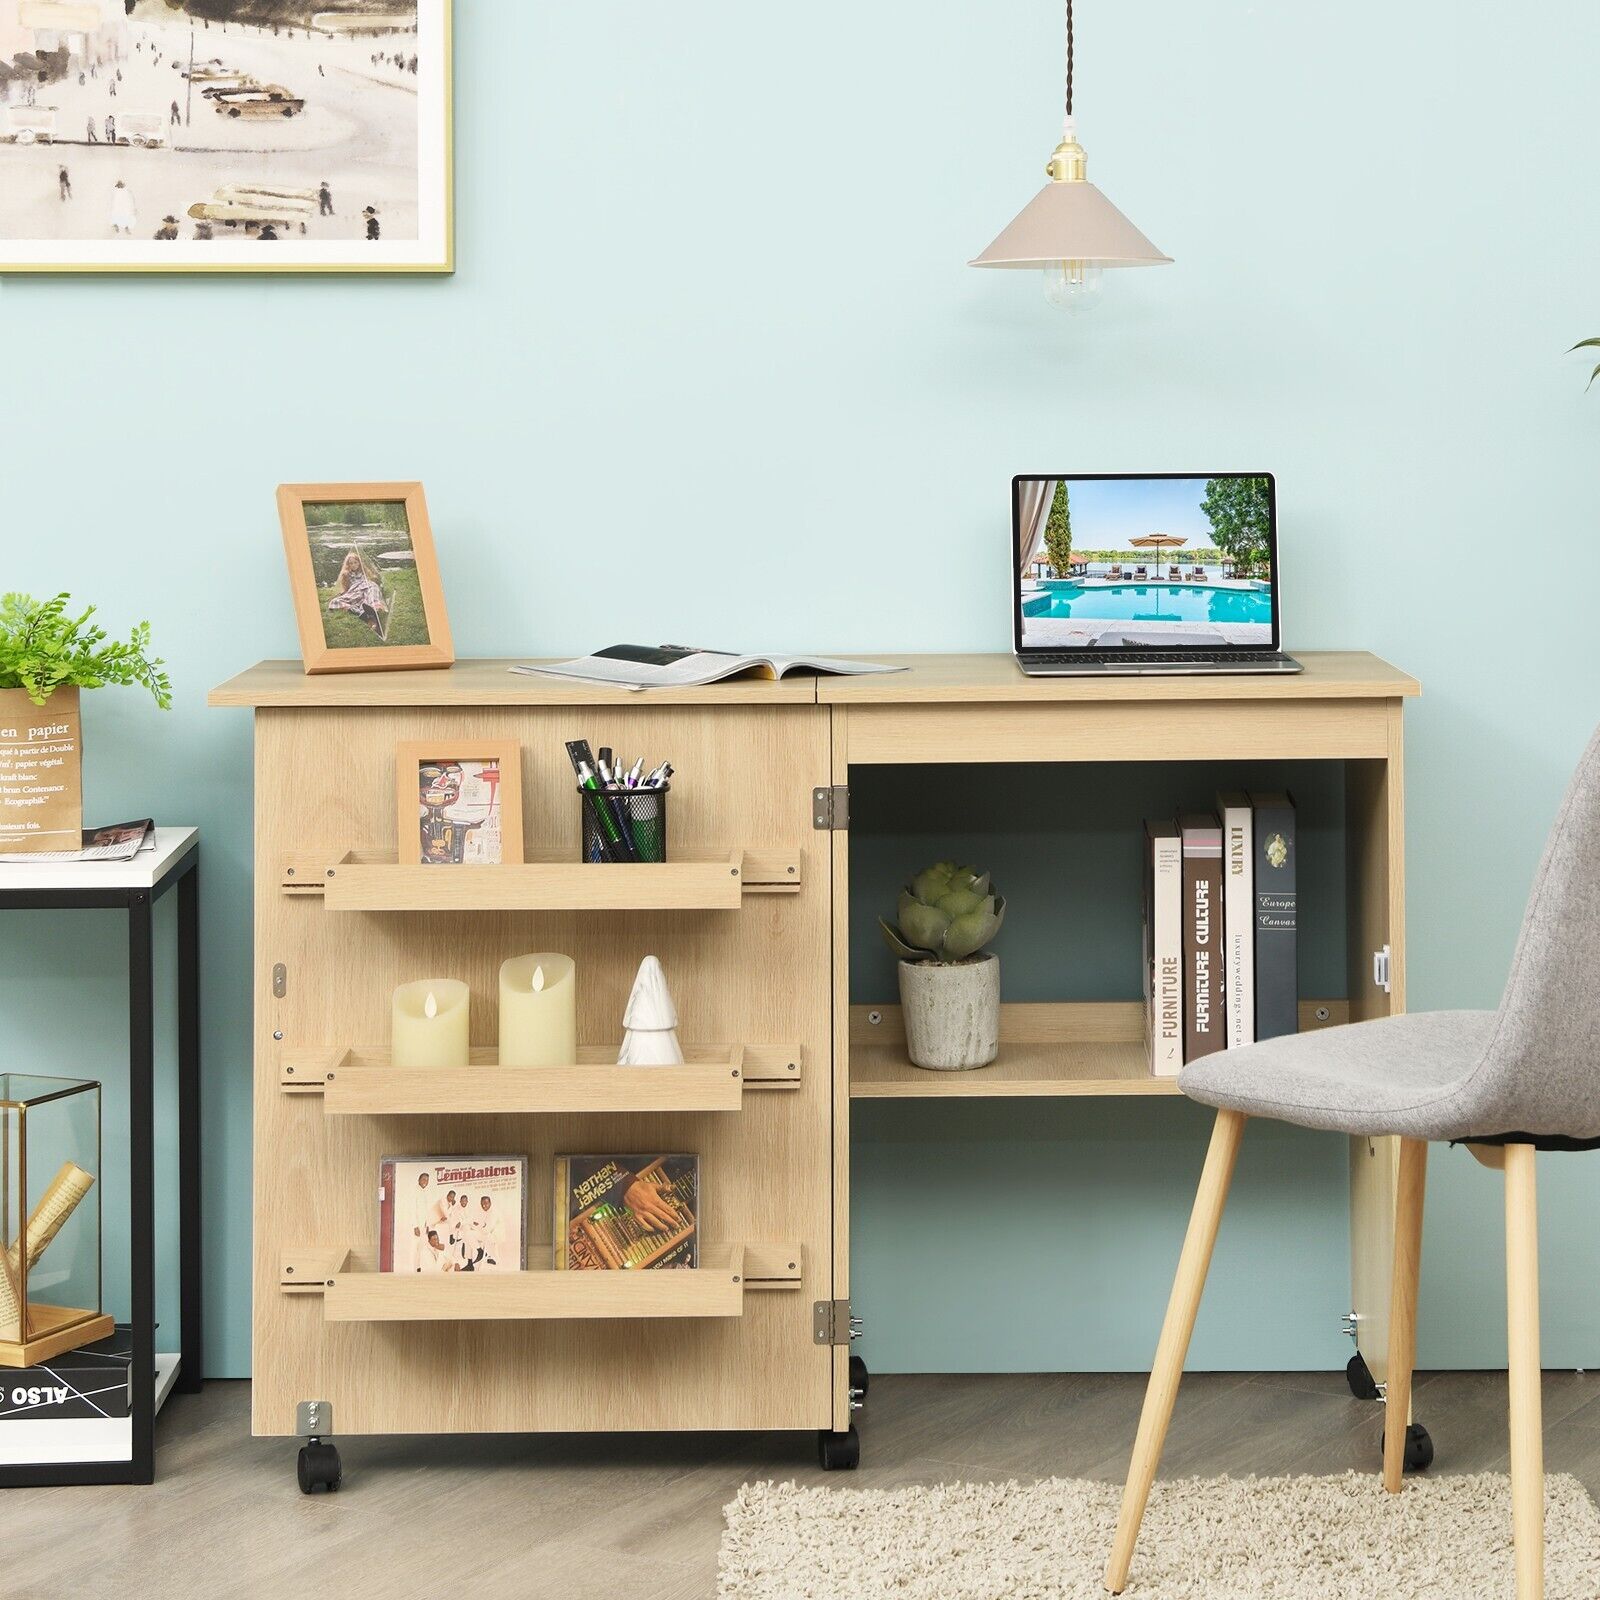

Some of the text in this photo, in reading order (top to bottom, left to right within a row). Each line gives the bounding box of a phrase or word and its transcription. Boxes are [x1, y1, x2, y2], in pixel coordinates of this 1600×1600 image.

[1, 722, 70, 741] en papier
[50, 743, 75, 753] Double
[15, 759, 38, 770] papier
[1231, 827, 1244, 877] LUXURY
[1259, 896, 1297, 911] Europe
[1259, 915, 1297, 926] Canvas
[1195, 880, 1210, 1033] FURNITURE CULTURE
[1162, 957, 1178, 1039] FURNITURE
[434, 1165, 517, 1183] Temptations
[12, 1386, 69, 1405] ALSO
